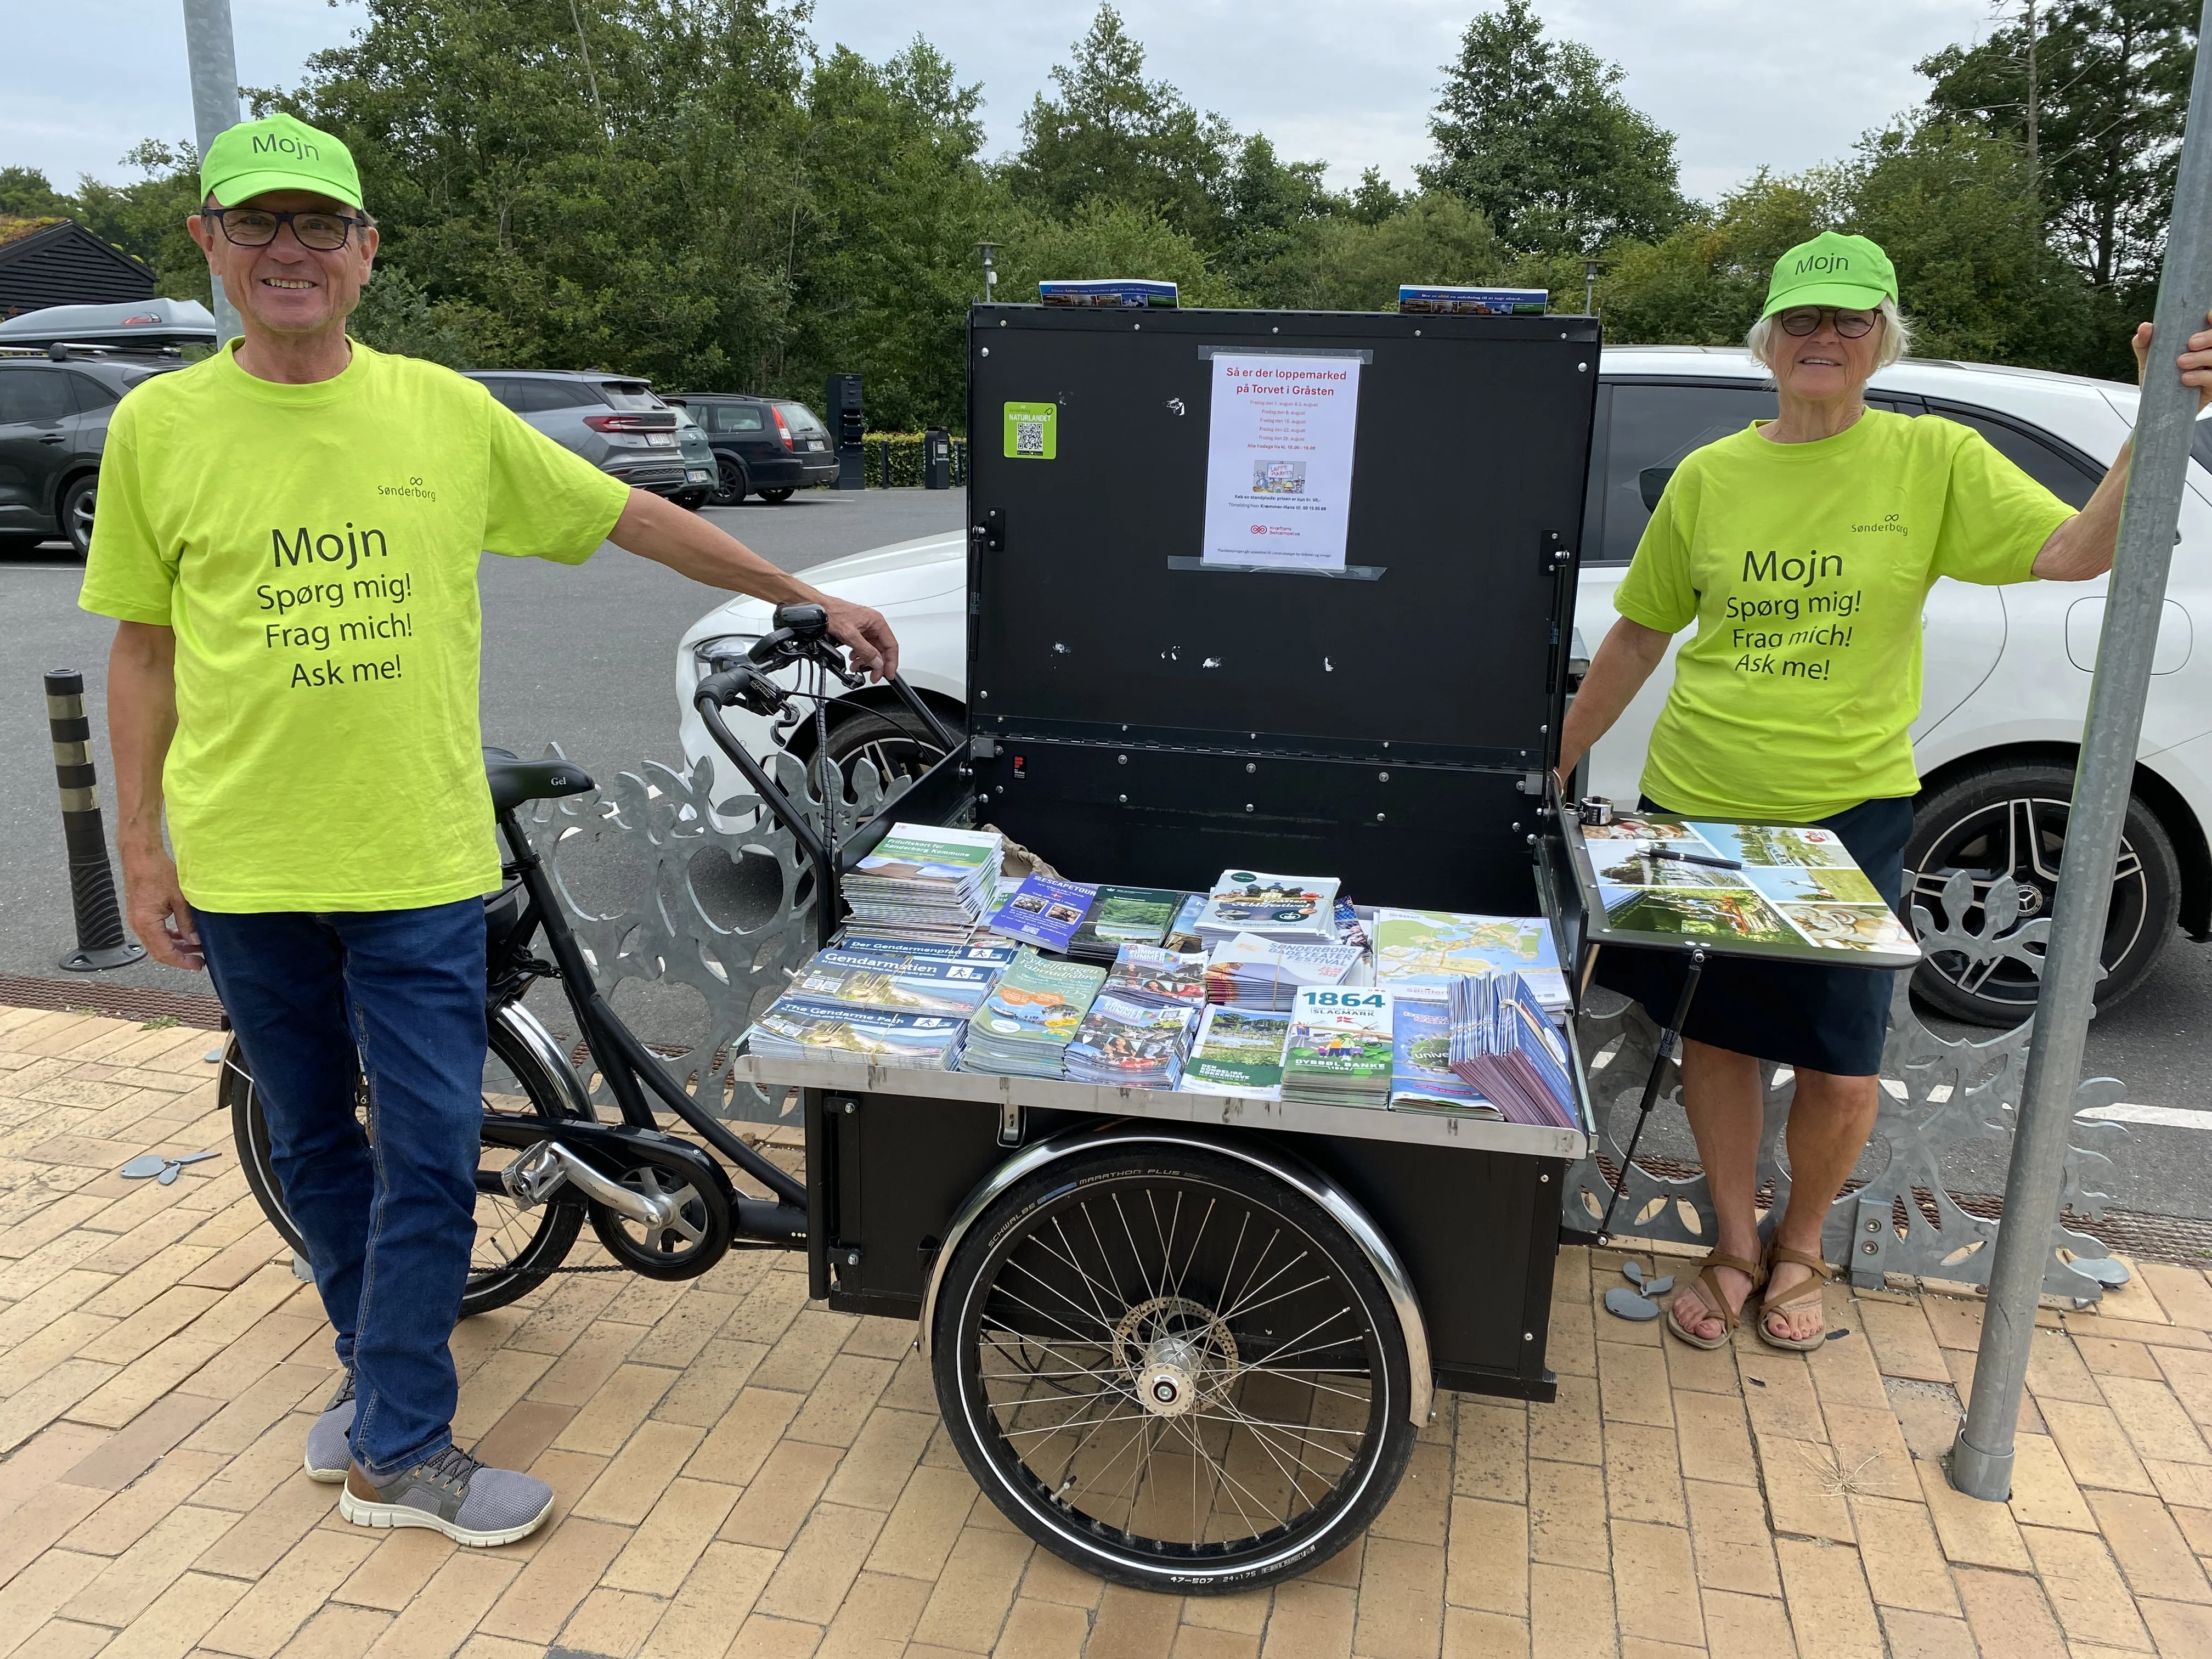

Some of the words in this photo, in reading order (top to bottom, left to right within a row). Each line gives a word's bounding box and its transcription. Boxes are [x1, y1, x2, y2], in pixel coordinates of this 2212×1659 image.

[252, 133, 319, 161] Mojn
[1795, 252, 1848, 275] Mojn
[1227, 366, 1239, 376] Så
[1256, 369, 1273, 377] der
[1276, 369, 1346, 380] loppemarked
[1237, 383, 1249, 394] på
[1252, 385, 1284, 394] Torvet
[1286, 386, 1289, 394] i
[1293, 385, 1334, 396] Gråsten
[1009, 414, 1052, 422] NATURLANDET
[377, 485, 436, 502] Sønderborg
[1851, 523, 1908, 536] Sønderborg
[272, 522, 387, 571] Mojn
[1742, 550, 1843, 588] Mojn
[257, 583, 344, 615] Spørg
[354, 573, 412, 603] mig!
[1726, 596, 1799, 622] Spørg
[1808, 590, 1861, 617] mig!
[266, 624, 330, 651] Frag
[340, 613, 413, 641] mich!
[1733, 628, 1783, 651] Frag
[1788, 624, 1853, 647] mich!
[291, 659, 345, 689] Ask
[352, 654, 402, 682] me!
[1735, 653, 1776, 675] Ask
[1782, 659, 1830, 681] me!
[551, 775, 567, 786] Gel
[883, 843, 929, 854] Sønderborg
[931, 849, 970, 857] Kommune
[887, 839, 931, 849] Friluftskort
[1041, 876, 1097, 896] ESCAPETOUR
[873, 944, 962, 955] Gendarmenpfad
[1268, 948, 1353, 961] GADETEATER
[1269, 943, 1357, 954] SØNDERBORG
[825, 953, 937, 973] Gendarmstien
[1023, 952, 1099, 975] Cykelfærgen
[1128, 952, 1165, 962] SUMMER
[1286, 955, 1347, 967] FESTIVAL
[1105, 1000, 1144, 1015] SOMMER
[1302, 992, 1386, 1008] 1864
[785, 1003, 808, 1012] The
[810, 1008, 874, 1020] Gendarme
[877, 1016, 904, 1024] Path
[1103, 1005, 1142, 1020] SUMMER
[1199, 1070, 1250, 1080] KØKKENHAVE
[1200, 1067, 1244, 1075] KONGELIGE
[988, 1201, 1036, 1249] SCHWALBE
[1079, 1169, 1142, 1186] MARATHON
[1170, 1576, 1214, 1584] 47-507
